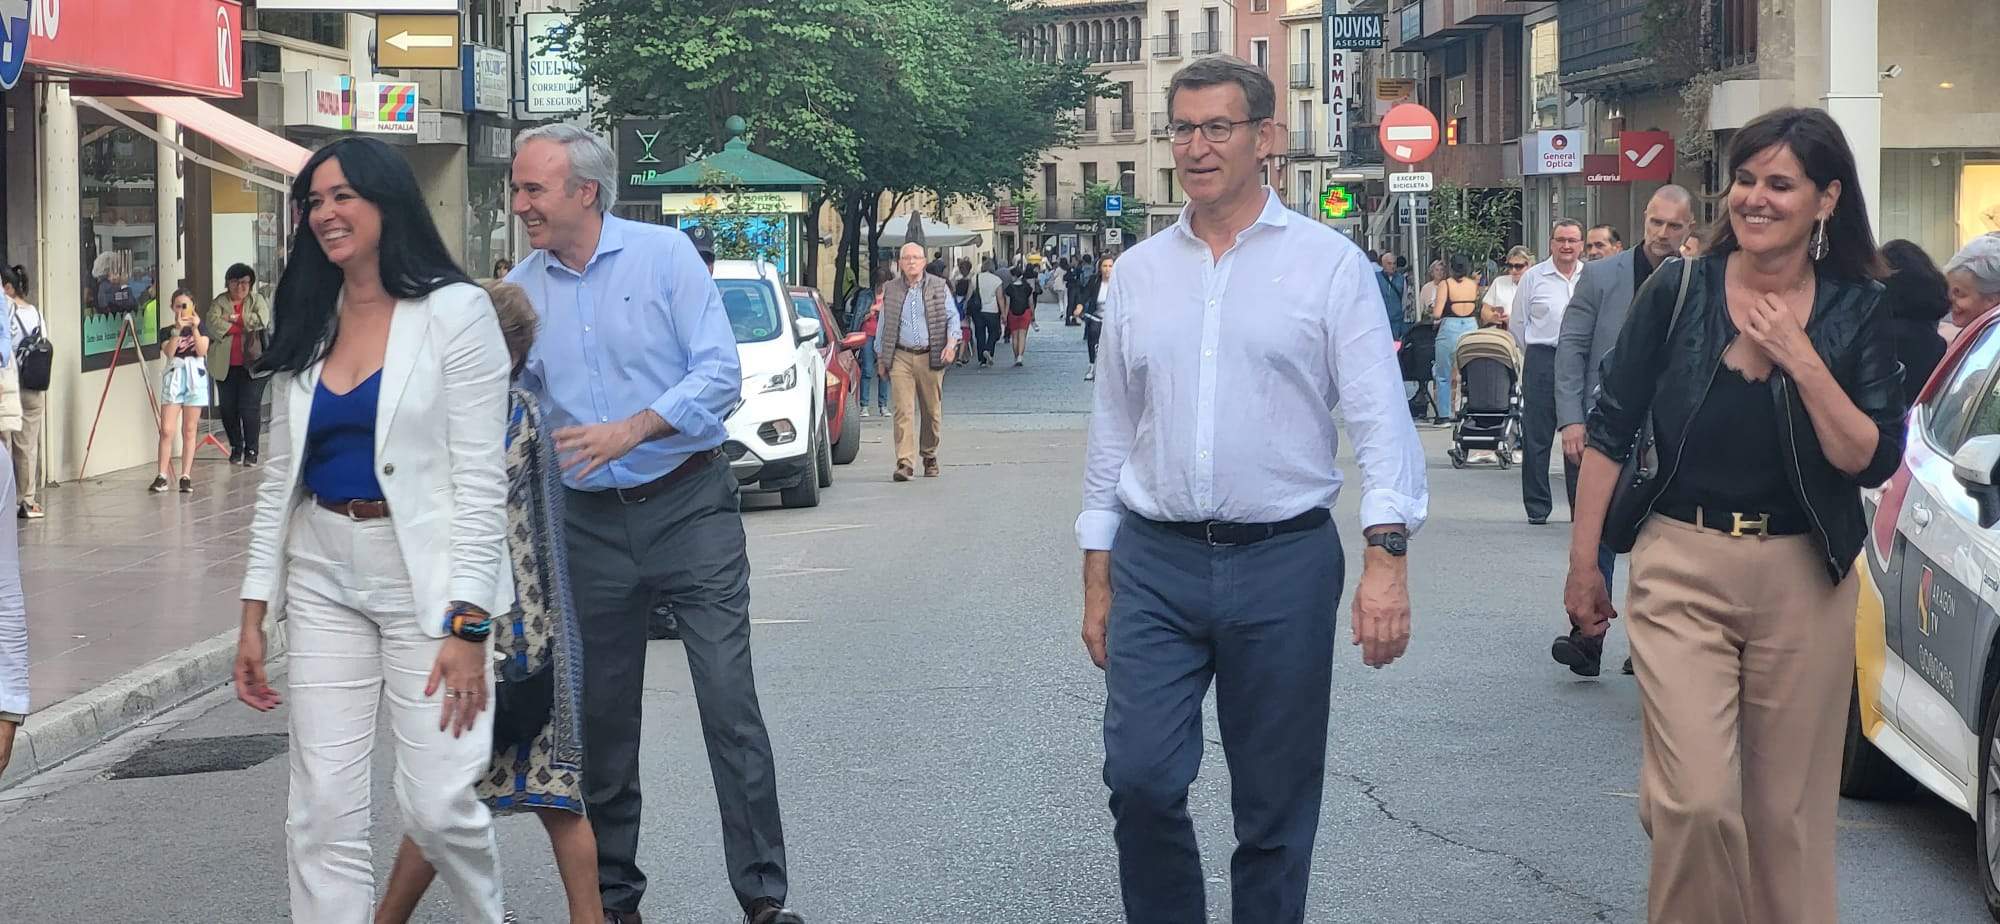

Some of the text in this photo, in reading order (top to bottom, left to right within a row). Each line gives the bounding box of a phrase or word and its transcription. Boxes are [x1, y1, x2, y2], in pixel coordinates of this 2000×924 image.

[1334, 16, 1381, 38] DUVISA
[1335, 39, 1382, 47] ASESORES
[534, 97, 582, 106] DE SEGUROS
[1331, 53, 1344, 148] RMACIA
[377, 123, 414, 131] NAUTALIA
[1543, 152, 1576, 160] General
[1546, 160, 1573, 168] Optica
